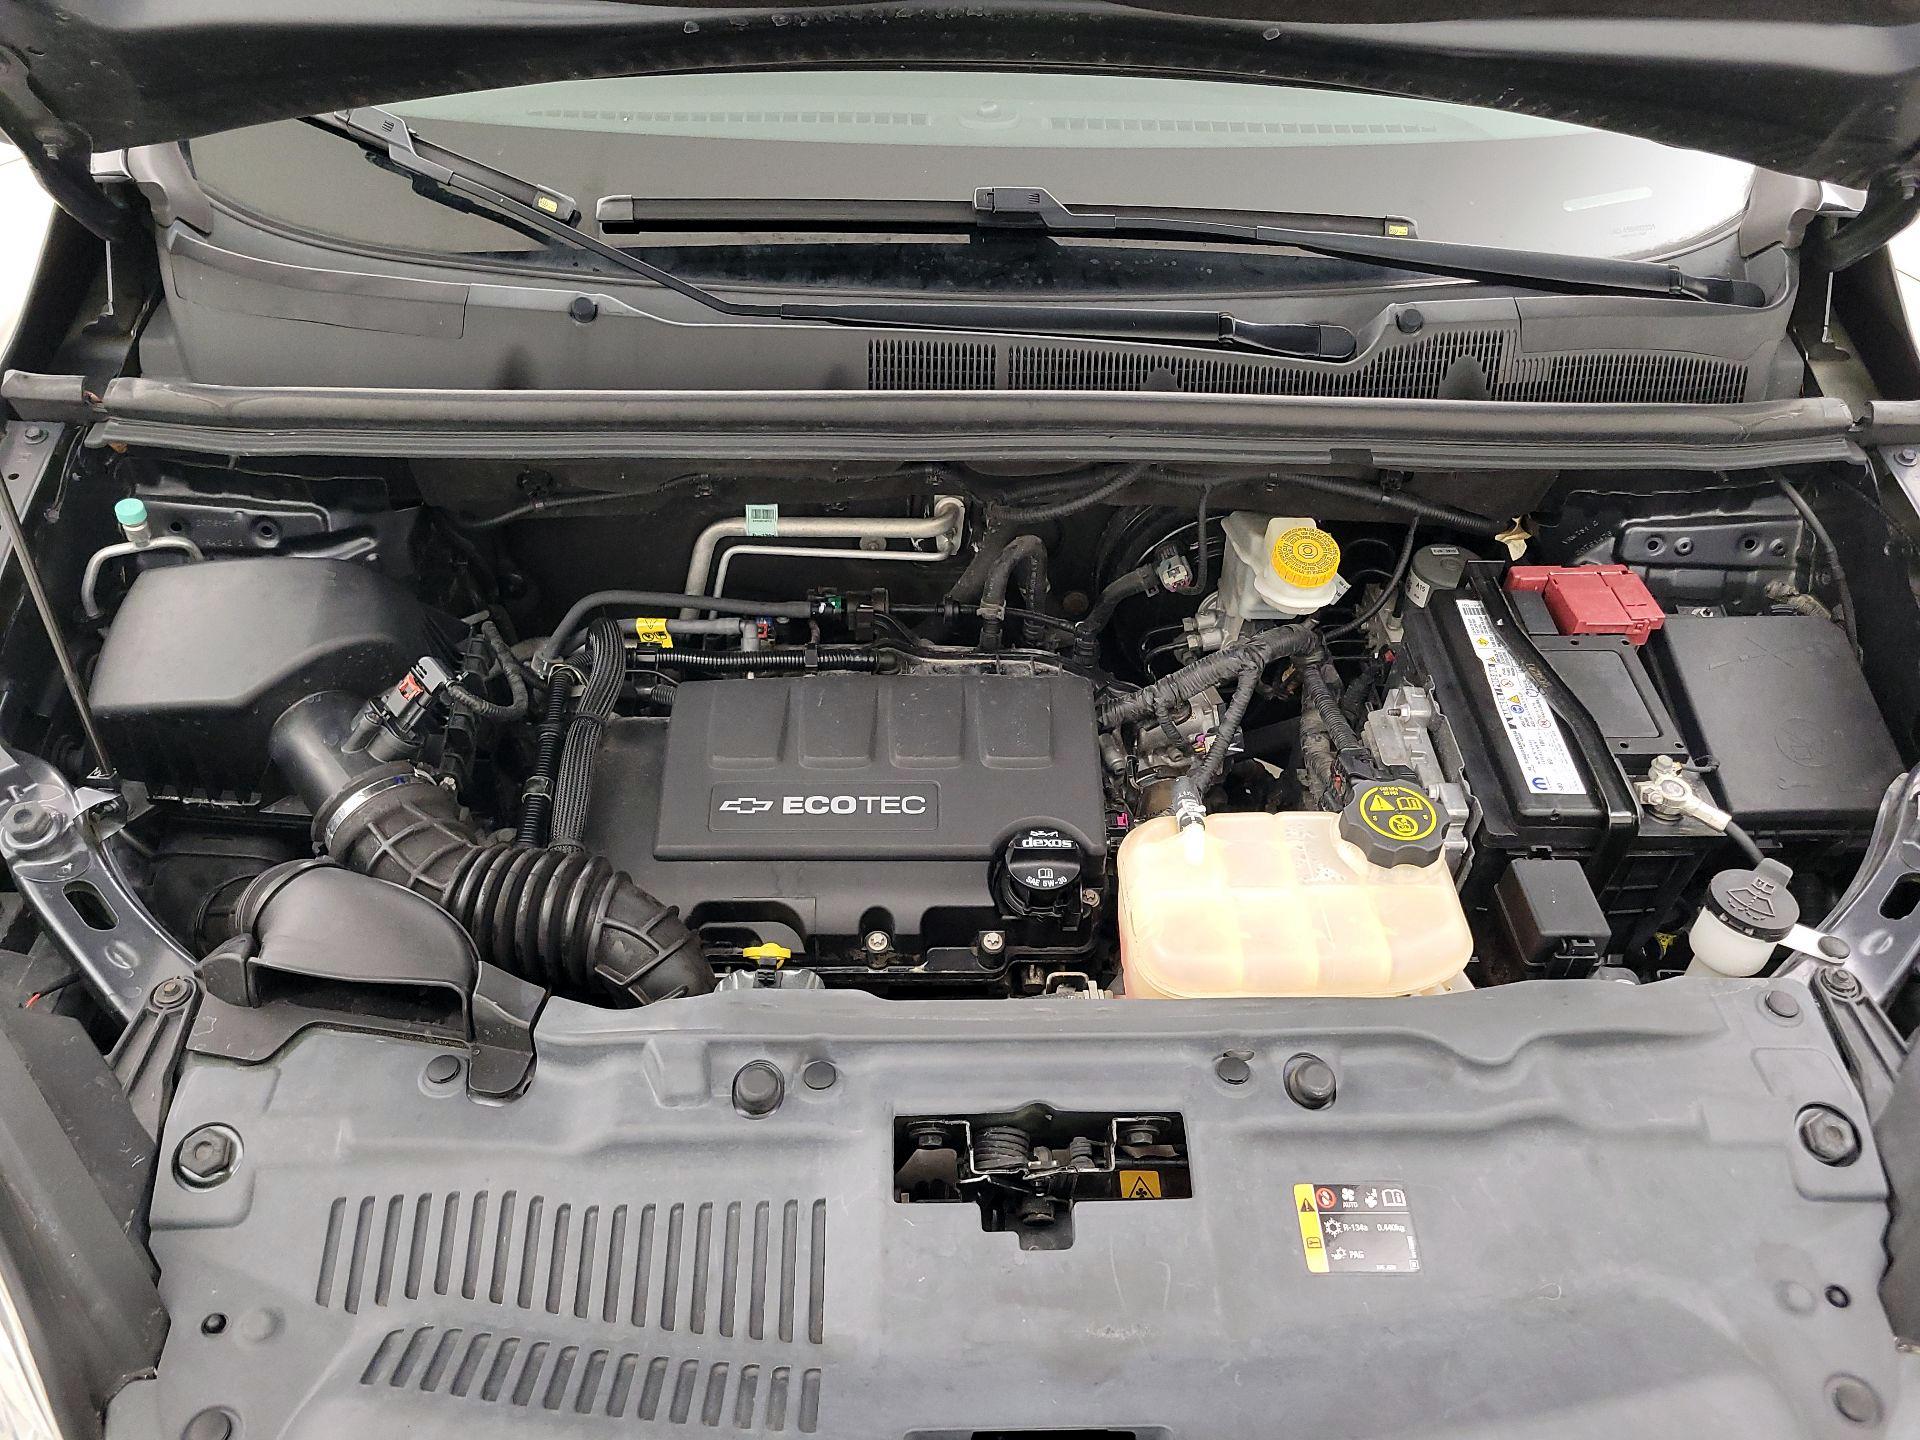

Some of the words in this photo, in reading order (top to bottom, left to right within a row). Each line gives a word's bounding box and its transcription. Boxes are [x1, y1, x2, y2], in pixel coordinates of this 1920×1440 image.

[782, 795, 927, 815] ECOTEC
[1021, 836, 1074, 848] dexos
[1025, 875, 1041, 887] SAE
[1042, 876, 1068, 888] 5W-30
[1342, 1201, 1359, 1209] AUTO
[1342, 1223, 1369, 1232] R-134a
[1348, 1250, 1365, 1260] PAG
